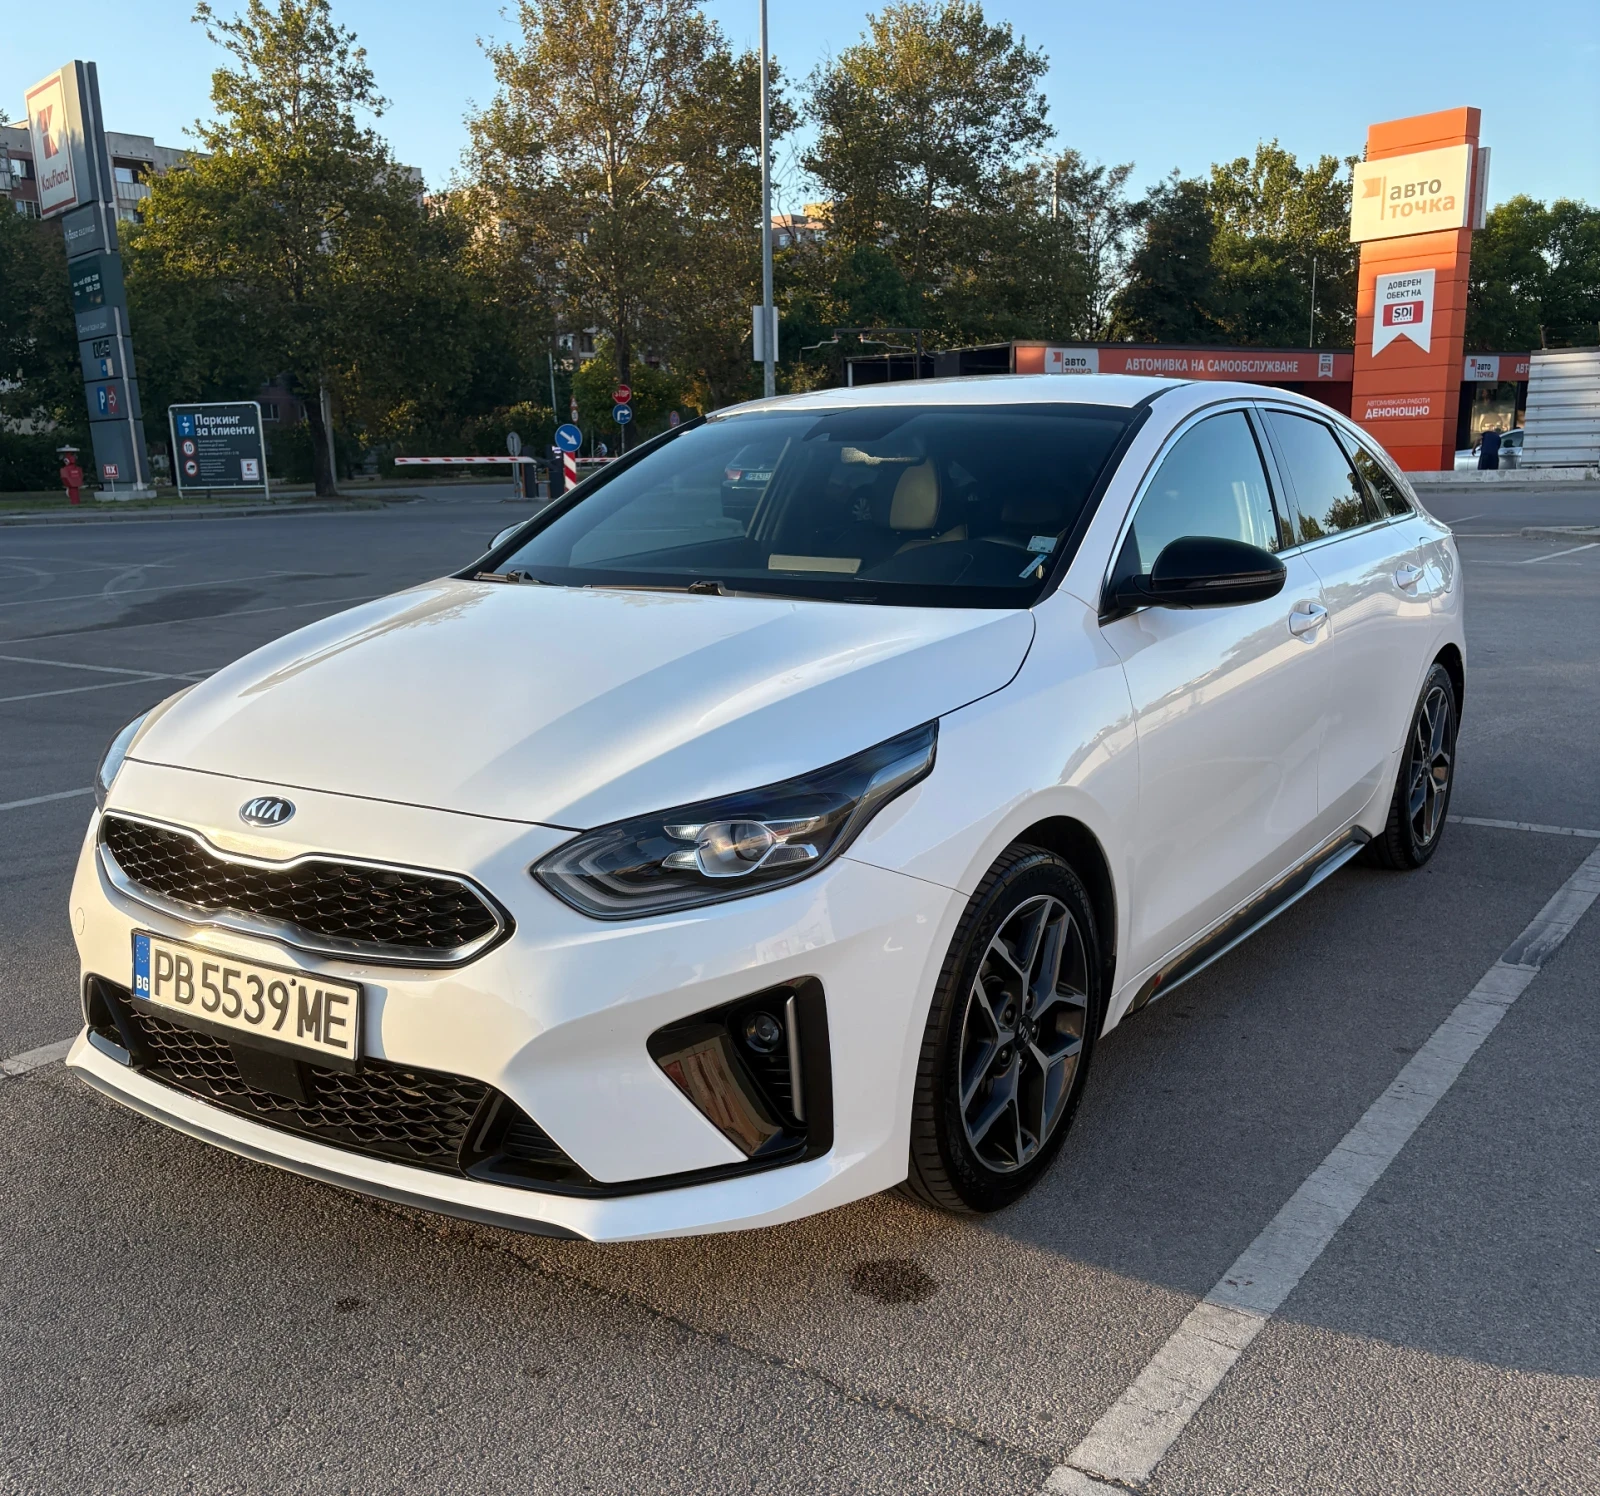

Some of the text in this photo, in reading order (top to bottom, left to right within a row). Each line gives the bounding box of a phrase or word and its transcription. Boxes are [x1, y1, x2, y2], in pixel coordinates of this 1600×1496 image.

[41, 167, 70, 192] Kaufland
[1390, 179, 1442, 201] авто
[1389, 195, 1455, 219] точка
[1387, 278, 1422, 290] ДОВЕРЕН
[1386, 289, 1422, 299] ОБЕКТ НА
[1393, 306, 1412, 318] SDI
[1065, 358, 1086, 366] авто
[1125, 358, 1298, 373] АВТОМИВКА НА САМООБСЛУЖВАНЕ
[1515, 363, 1530, 374] АВТ
[1366, 398, 1406, 407] АВТОМИВКАТА
[1365, 405, 1430, 419] ДЕНОНОЩНО
[194, 414, 240, 427] Паркинг
[196, 426, 255, 436] за клиенти
[185, 443, 192, 453] 10
[245, 799, 284, 821] KIA
[136, 974, 149, 992] BG
[153, 948, 350, 1049] PB 5539 ME
